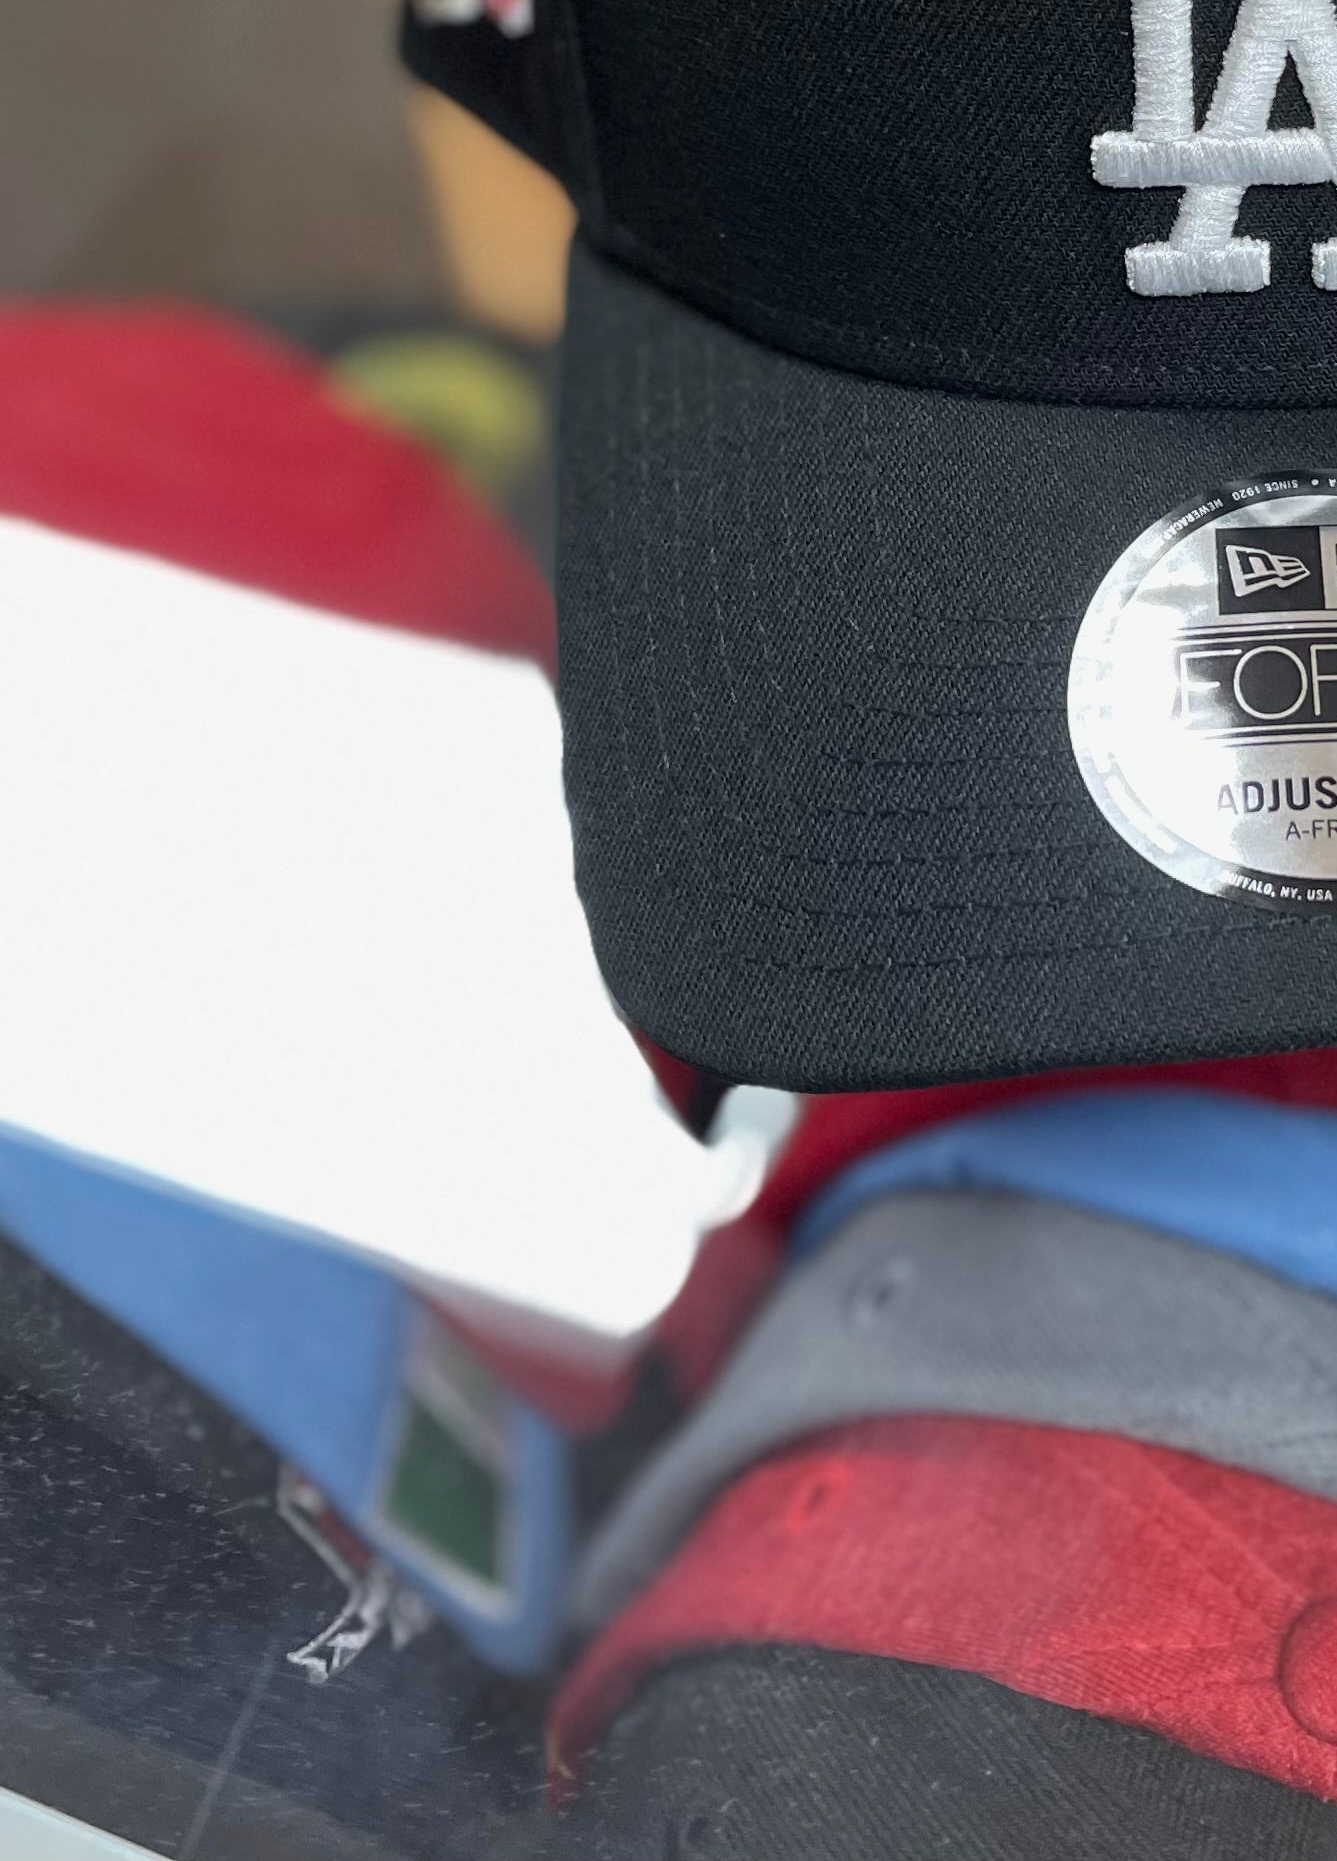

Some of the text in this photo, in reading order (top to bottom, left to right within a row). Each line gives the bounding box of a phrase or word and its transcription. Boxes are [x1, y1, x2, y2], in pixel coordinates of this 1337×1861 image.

[1264, 479, 1299, 493] SINCE
[1231, 486, 1261, 502] 1920
[1306, 888, 1334, 902] USA
